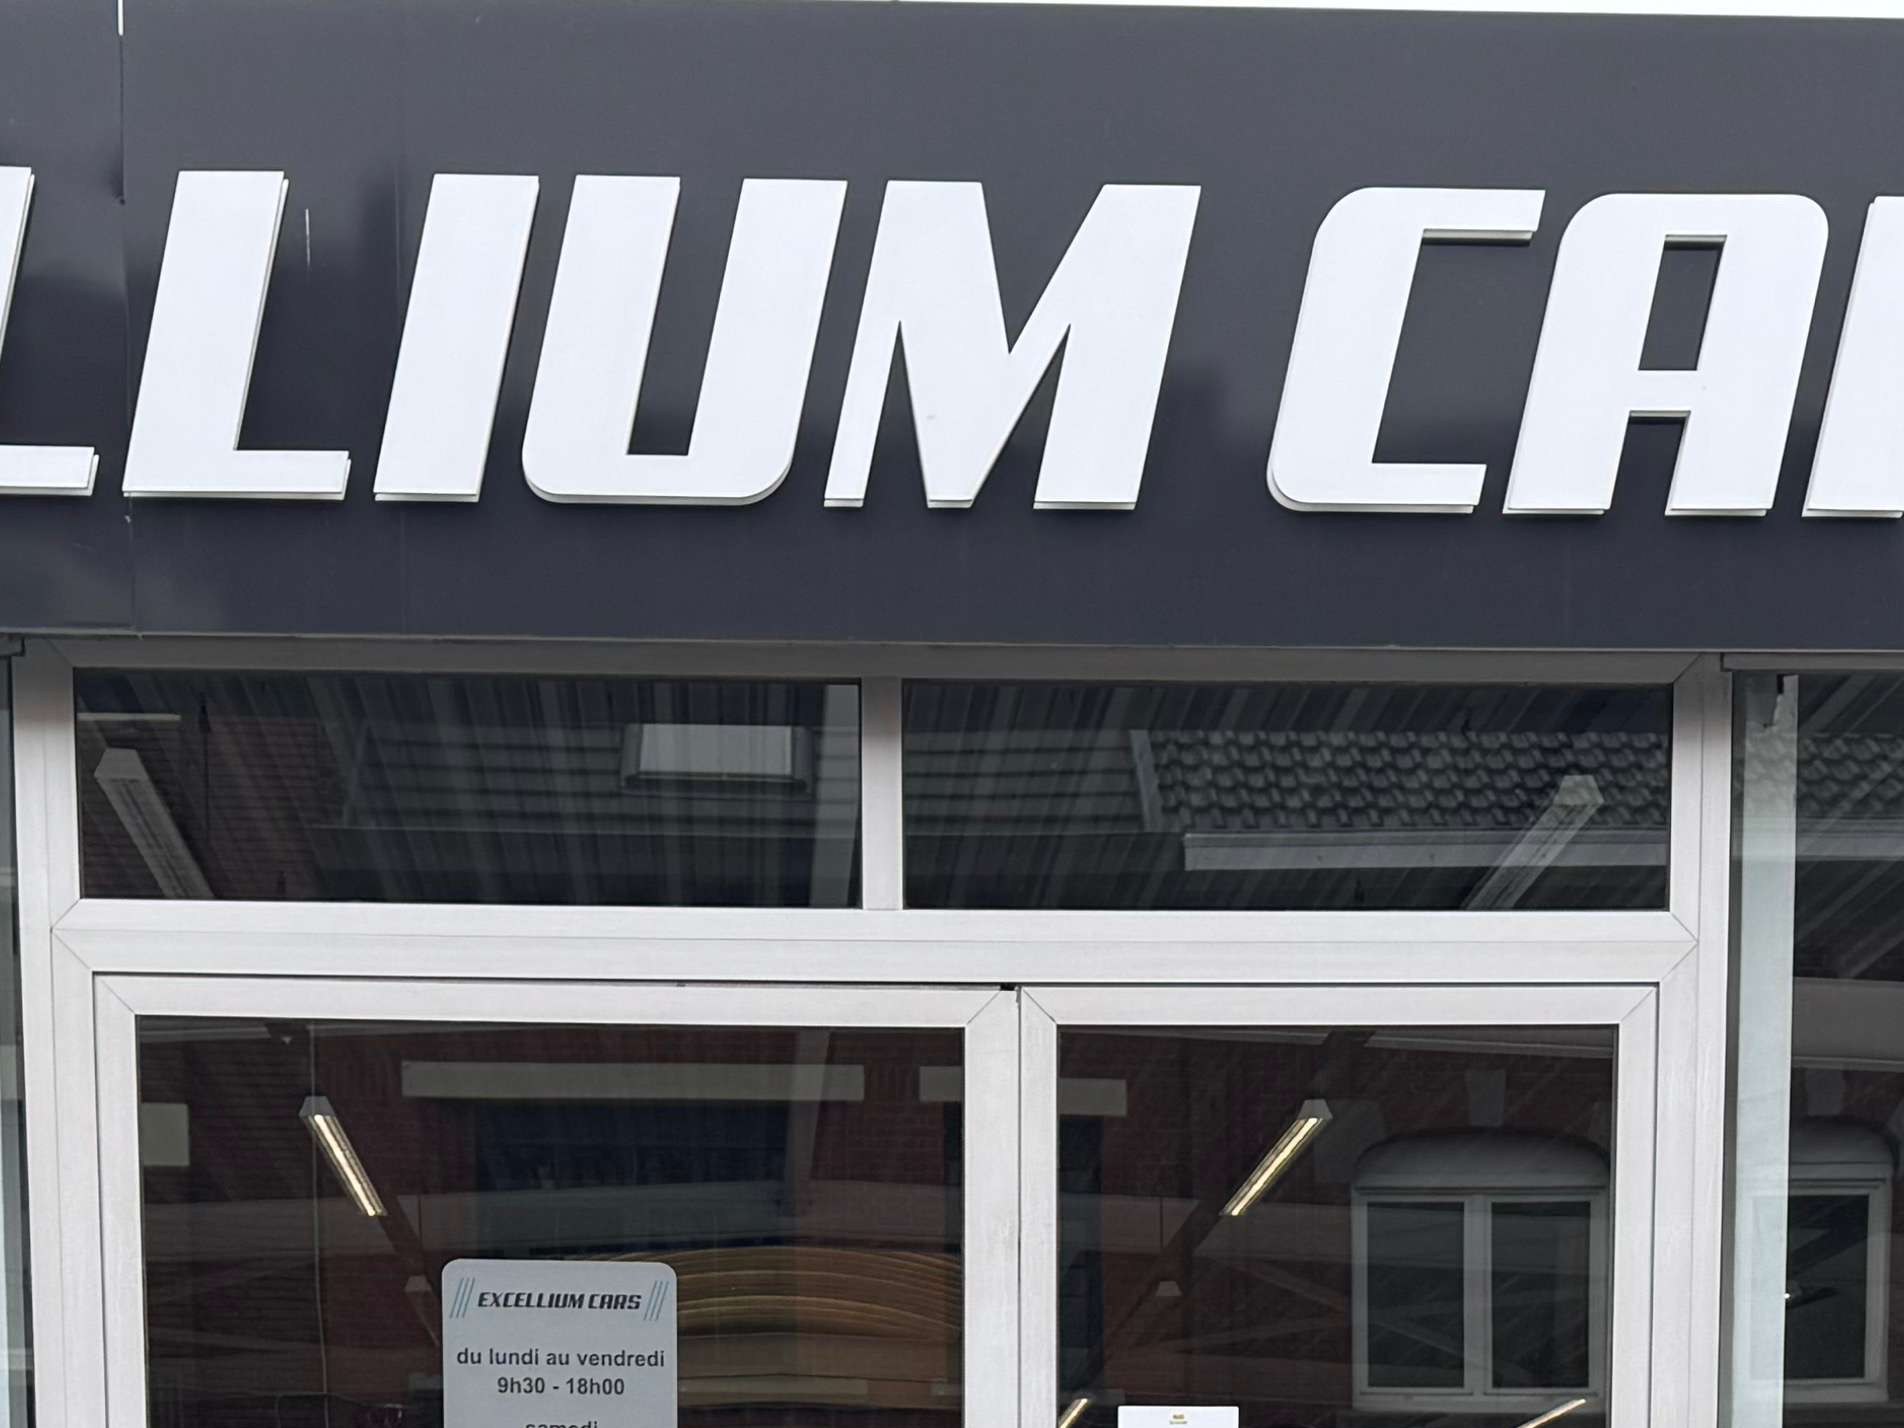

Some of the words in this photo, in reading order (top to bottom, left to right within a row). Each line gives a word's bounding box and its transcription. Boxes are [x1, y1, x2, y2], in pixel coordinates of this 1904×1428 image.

[478, 1291, 585, 1310] EXCELLIUM
[588, 1294, 642, 1310] CARS
[456, 1348, 481, 1365] du
[489, 1348, 539, 1366] lundi
[546, 1353, 570, 1366] au
[577, 1350, 665, 1367] vendredi
[497, 1377, 545, 1394] 9h30
[565, 1378, 625, 1395] 18h00
